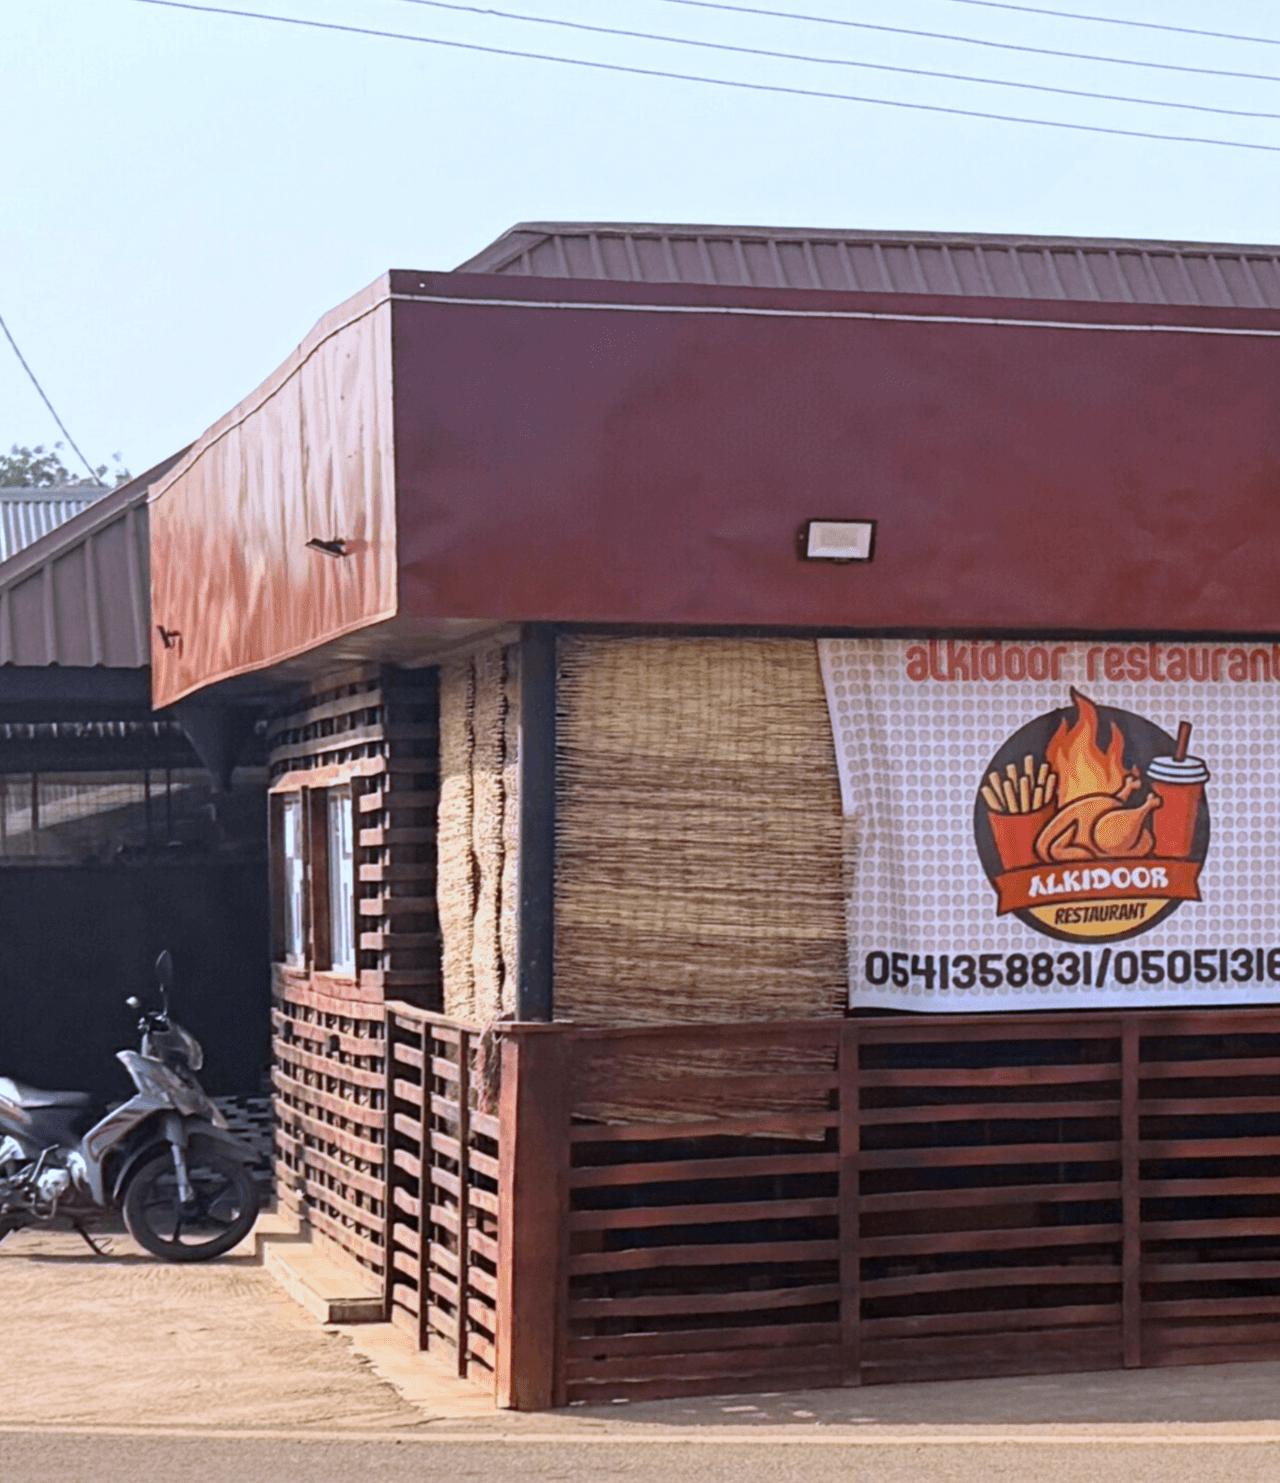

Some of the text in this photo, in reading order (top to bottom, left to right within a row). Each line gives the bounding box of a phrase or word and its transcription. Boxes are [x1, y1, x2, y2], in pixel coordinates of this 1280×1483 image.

[905, 640, 1067, 683] alkidoor
[1028, 866, 1169, 898] ALKIDOOR
[1054, 902, 1148, 926] RESTAURANT
